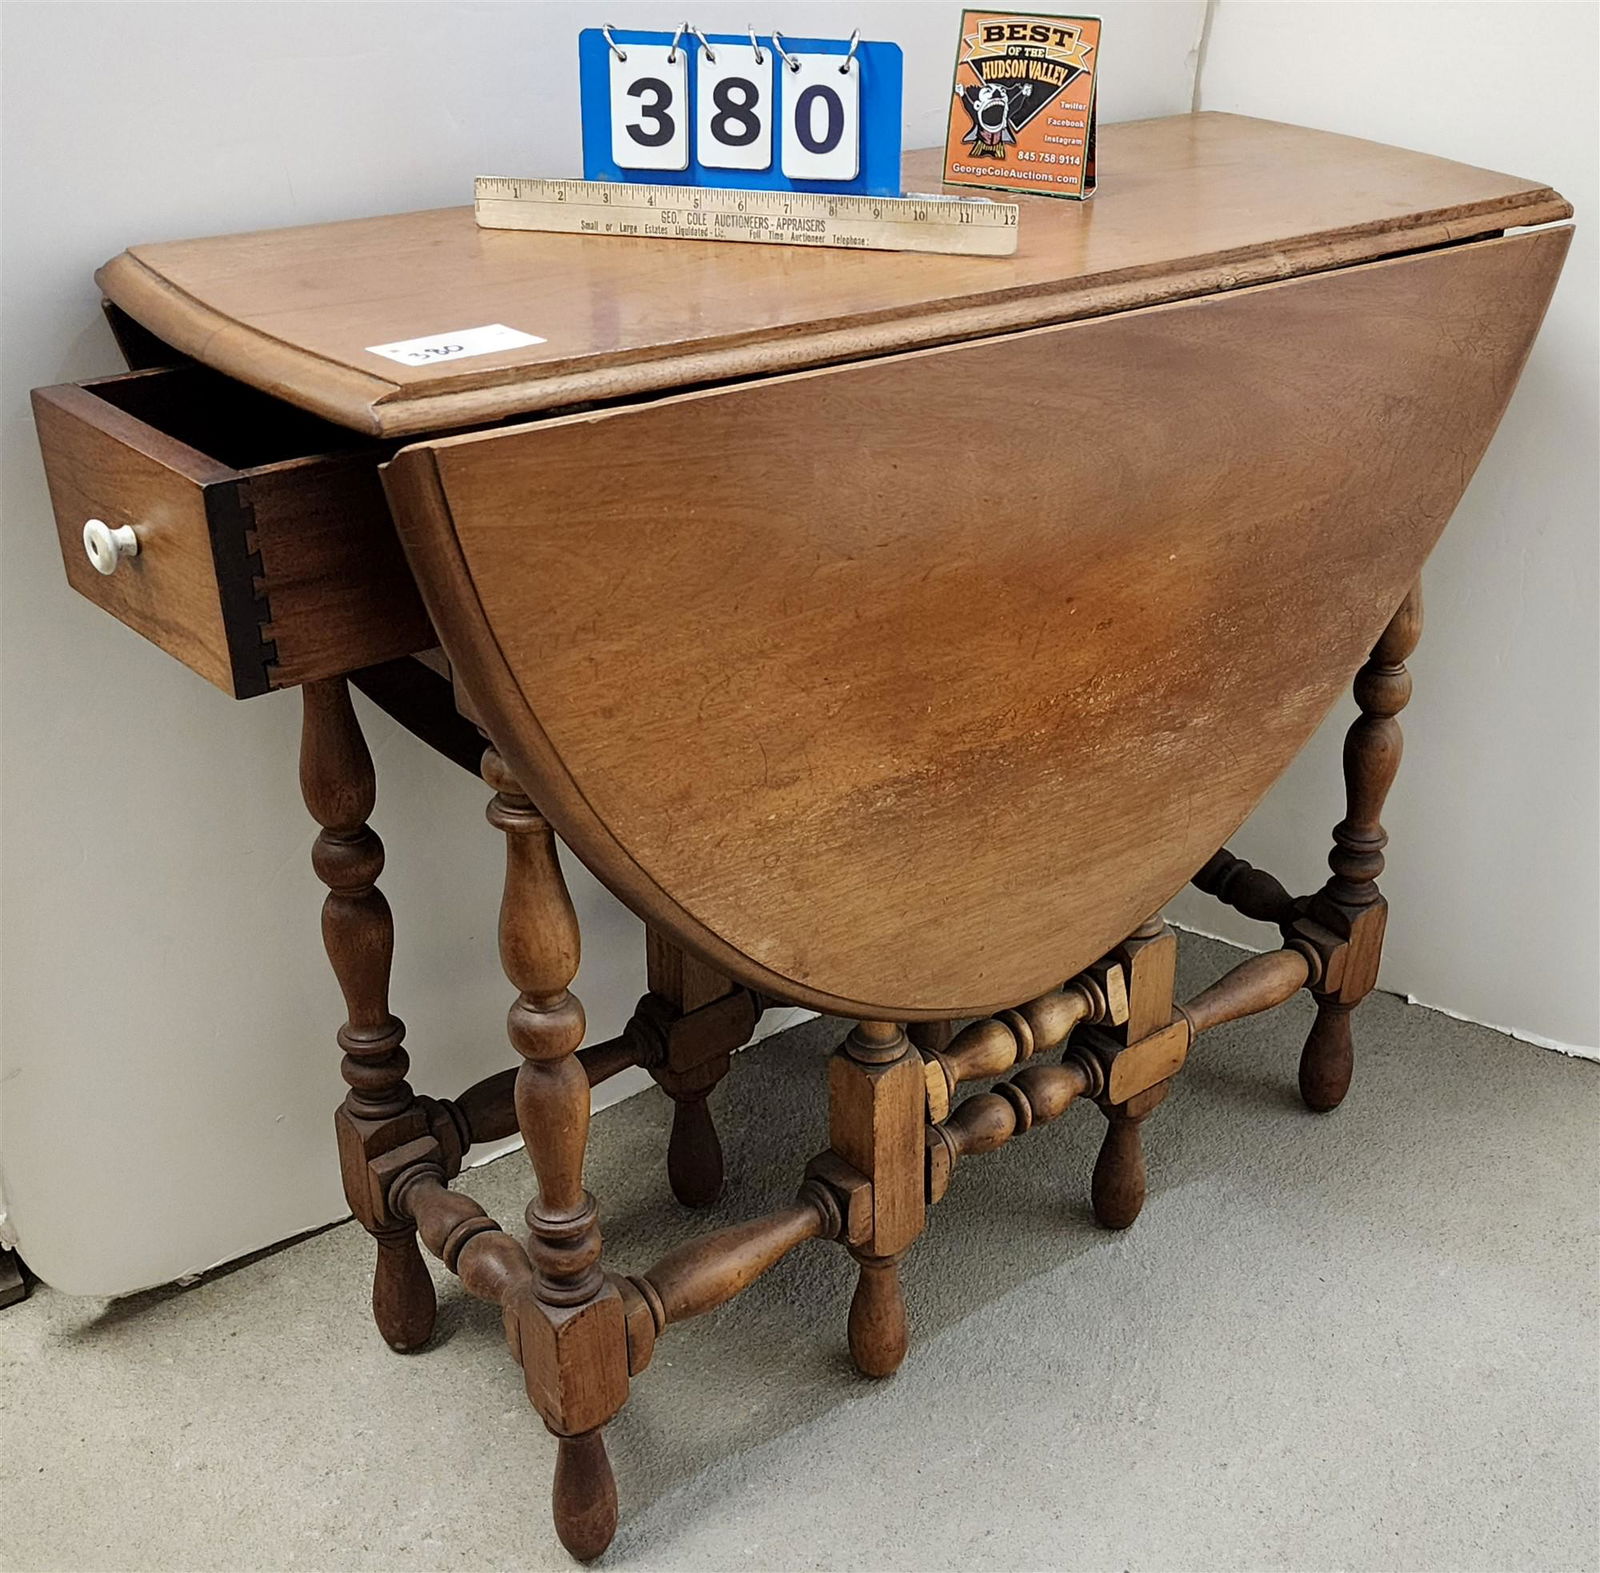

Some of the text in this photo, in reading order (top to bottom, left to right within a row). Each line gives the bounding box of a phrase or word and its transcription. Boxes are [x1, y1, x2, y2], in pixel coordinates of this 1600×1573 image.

[983, 24, 1074, 47] BEST
[1008, 46, 1045, 57] OF THE
[982, 59, 1068, 86] HUDSON VALLEY
[1060, 101, 1087, 110] Twitter
[1047, 117, 1085, 128] Facebook
[1044, 134, 1083, 146] Instagram
[952, 162, 1078, 183] GeorgeColeAuctions.com
[513, 187, 1016, 225] 1 2 3 4 5 6 7 8 9 10 11 12
[661, 210, 679, 224] GEO.
[687, 212, 707, 226] COLE
[580, 219, 599, 230] Small
[619, 222, 637, 234] Large
[645, 223, 668, 235] Estates
[791, 232, 825, 243] Auctioneer
[408, 345, 464, 360] 380
